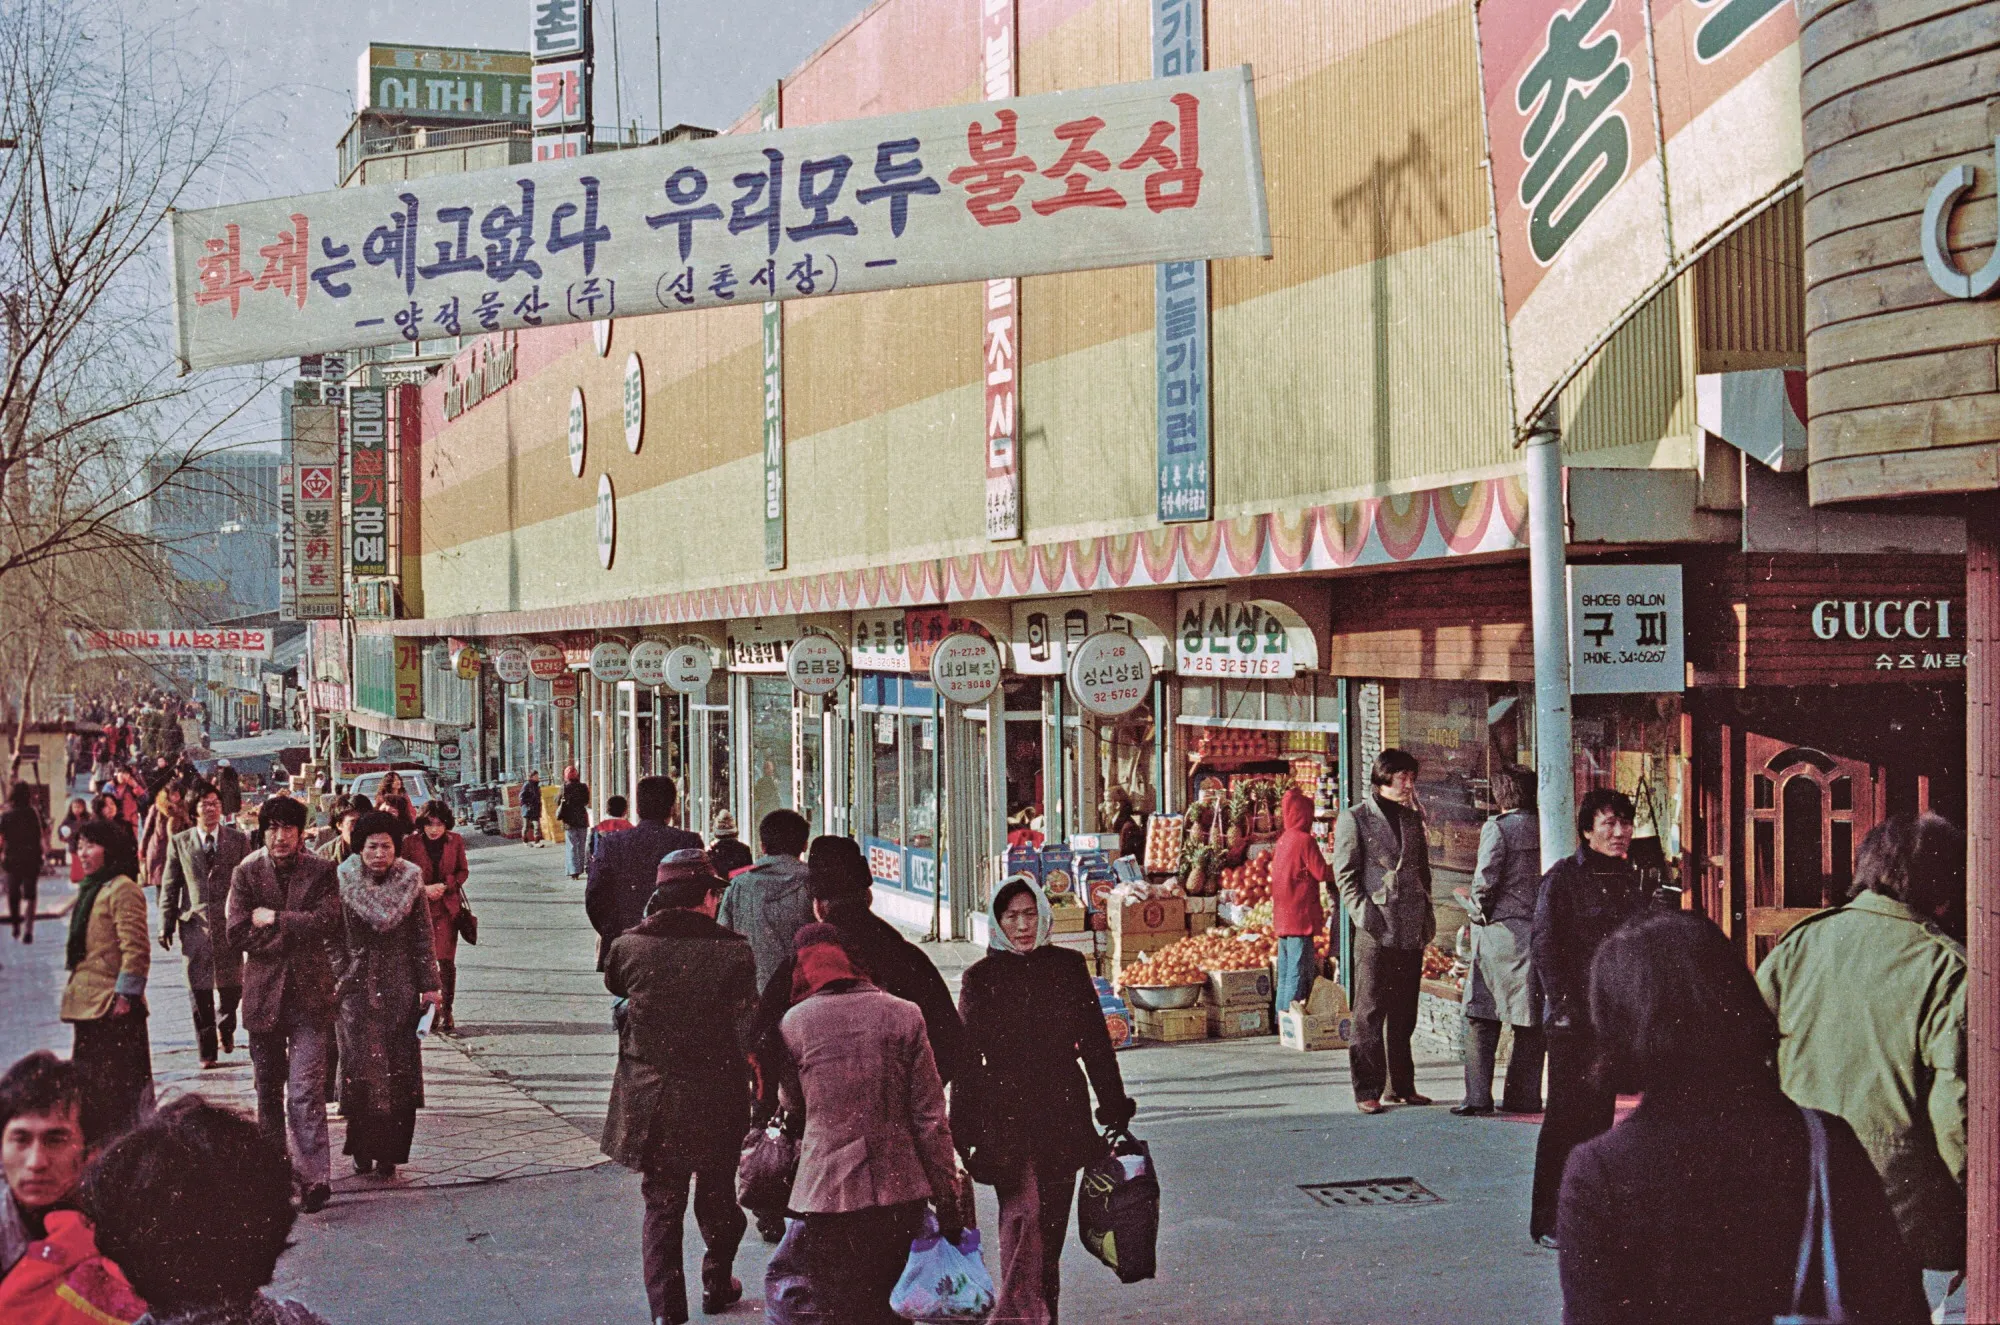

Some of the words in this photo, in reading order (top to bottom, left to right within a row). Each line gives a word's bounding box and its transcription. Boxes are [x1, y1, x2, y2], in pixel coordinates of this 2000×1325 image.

[1582, 594, 1621, 606] SHOES
[1626, 593, 1665, 606] SALON
[1811, 600, 1951, 640] GUCCI
[1083, 662, 1144, 687] 성신상회
[1093, 687, 1138, 702] 32-5762
